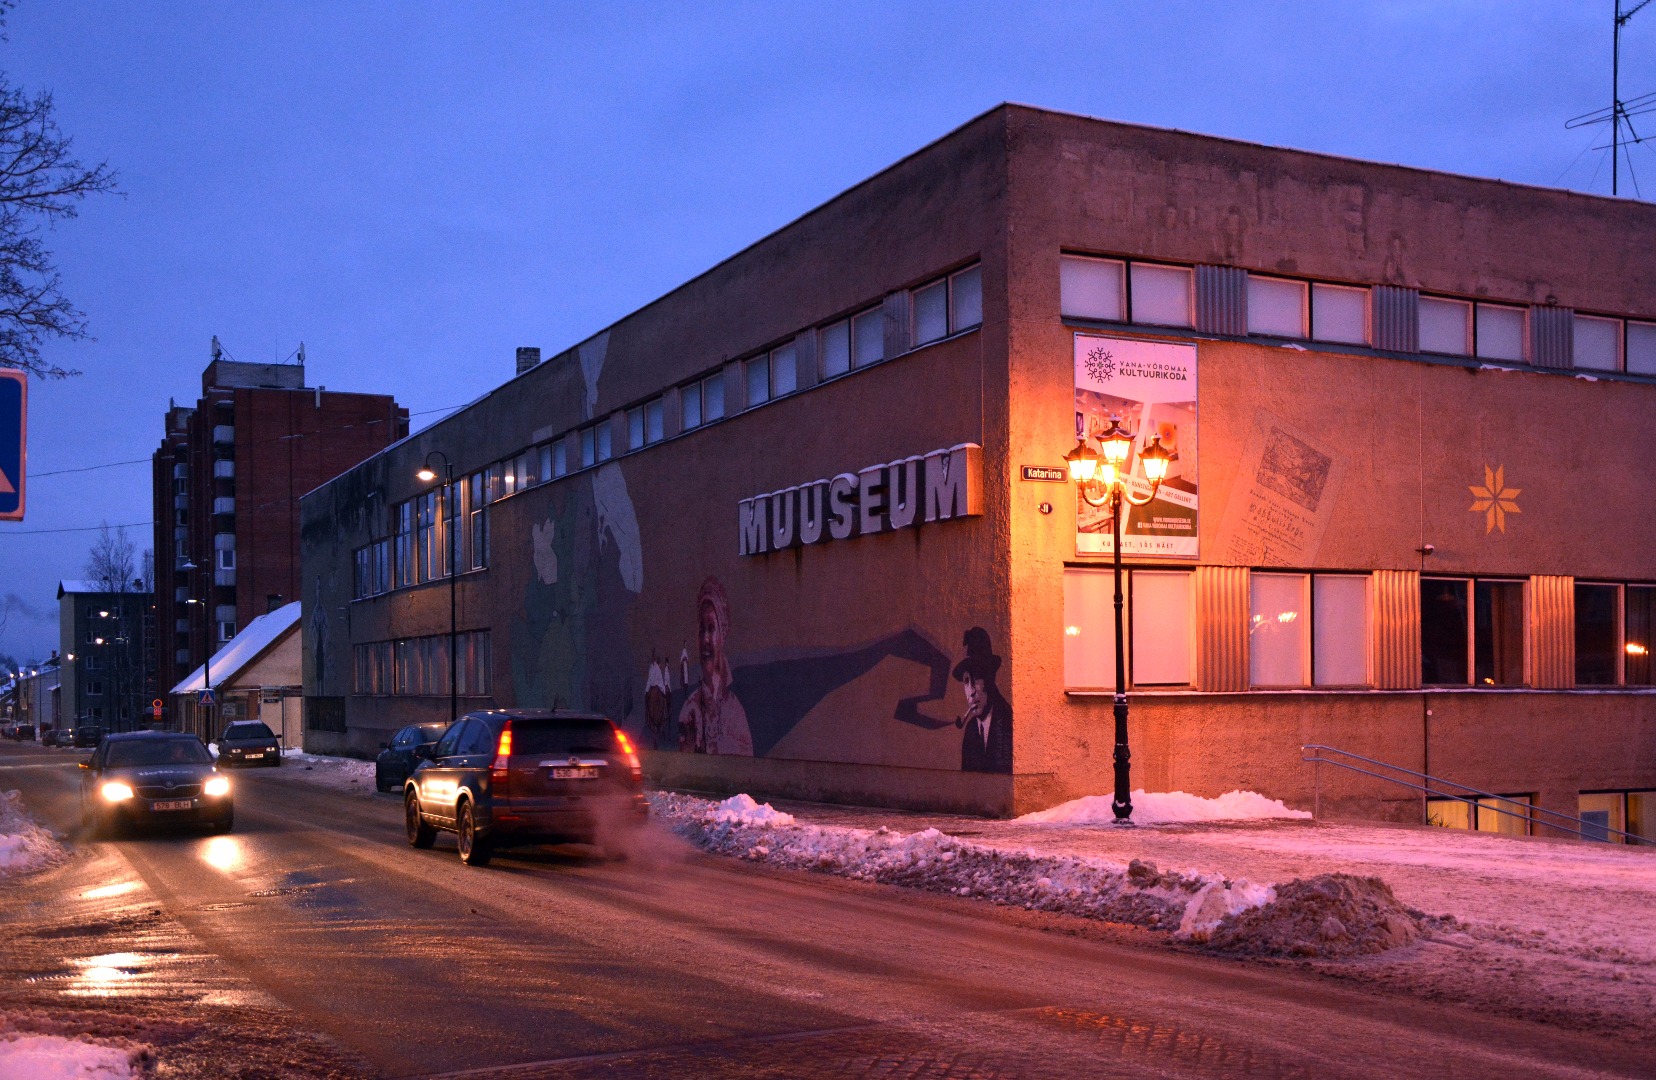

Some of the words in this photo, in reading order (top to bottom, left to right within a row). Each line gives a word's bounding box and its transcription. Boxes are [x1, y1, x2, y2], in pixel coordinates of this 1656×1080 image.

[1119, 368, 1187, 381] KULTUURIKODA
[1028, 468, 1062, 479] Katariina
[738, 444, 978, 556] MUUSEUM
[156, 802, 170, 810] 578
